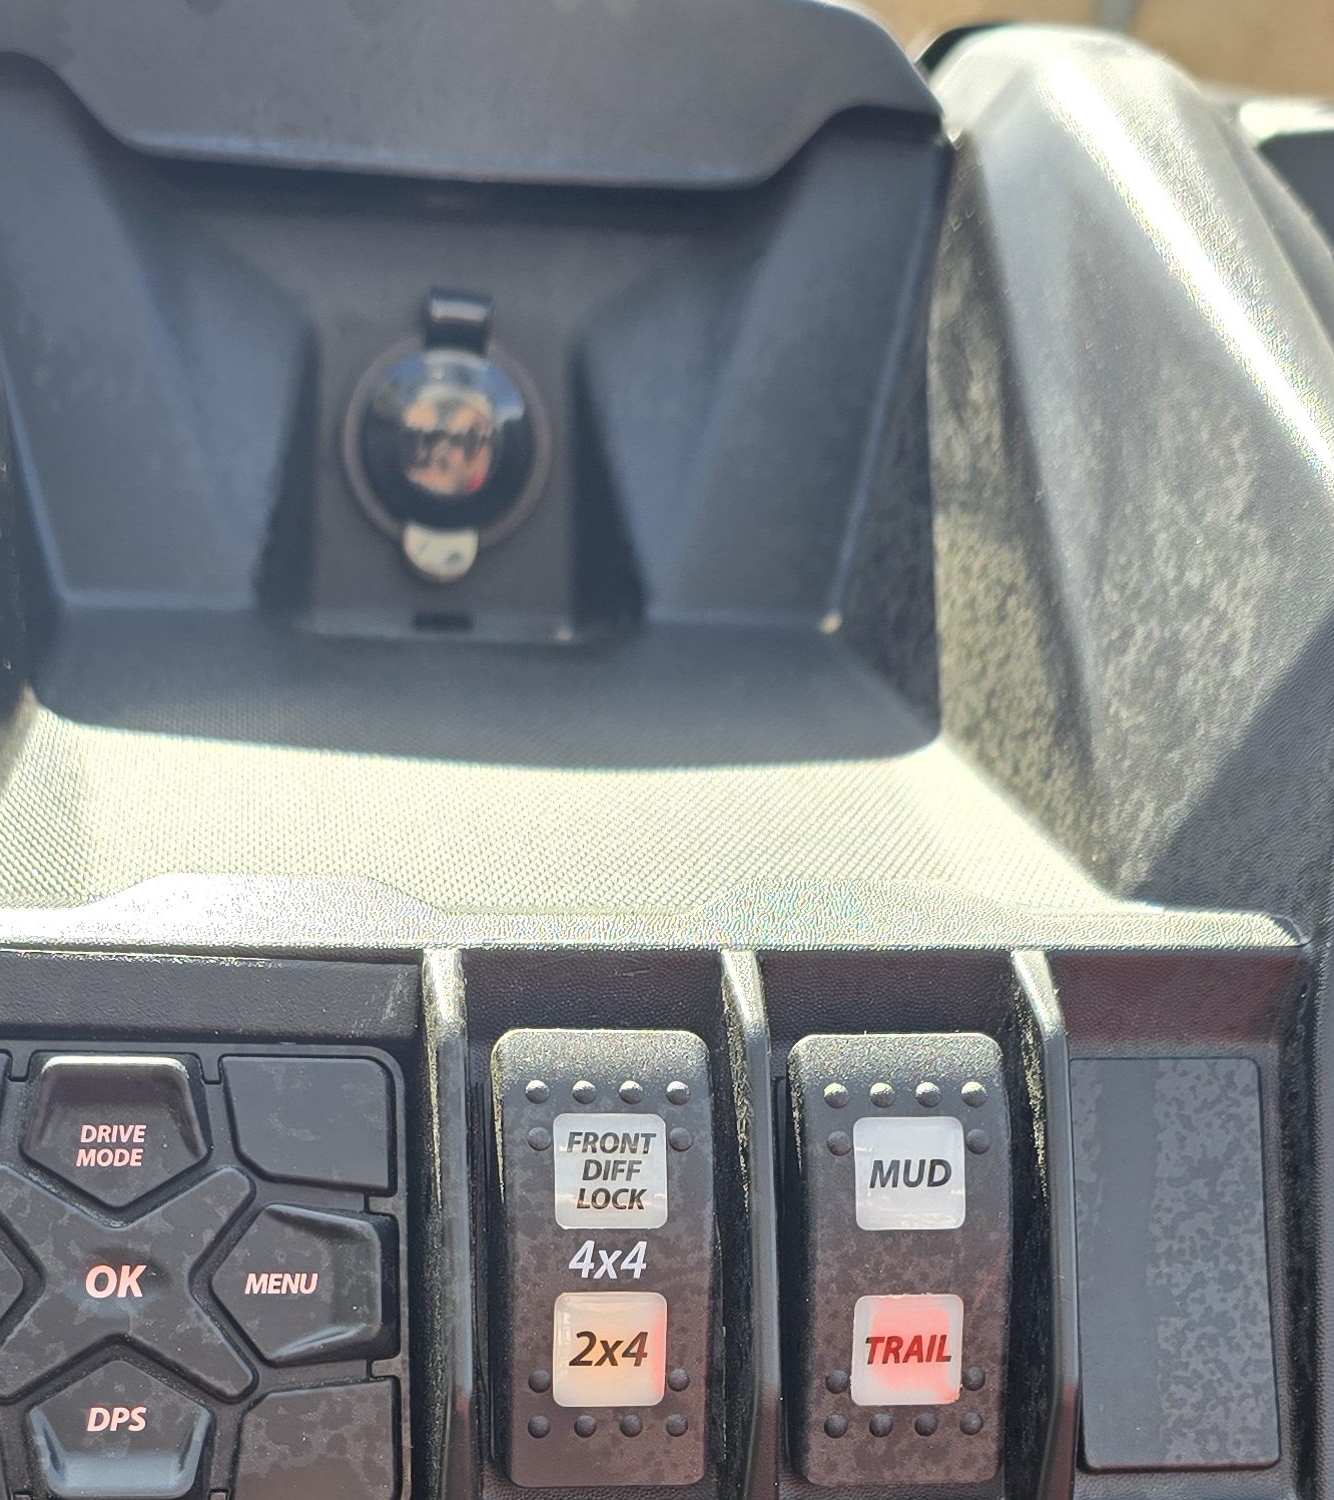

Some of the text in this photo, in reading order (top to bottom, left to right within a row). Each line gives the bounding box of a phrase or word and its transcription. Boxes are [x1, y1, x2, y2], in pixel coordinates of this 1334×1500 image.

[80, 1124, 147, 1143] DRIVE
[566, 1131, 657, 1155] FRONT
[76, 1148, 144, 1167] MODE
[581, 1159, 643, 1182] DIFF
[869, 1158, 953, 1189] MUD
[576, 1187, 648, 1210] LOCK
[568, 1240, 648, 1280] 4x4
[84, 1265, 147, 1299] OK
[244, 1273, 318, 1295] MENU
[568, 1330, 649, 1367] 2x4
[865, 1334, 953, 1365] TRAIL
[86, 1406, 147, 1432] DPS
